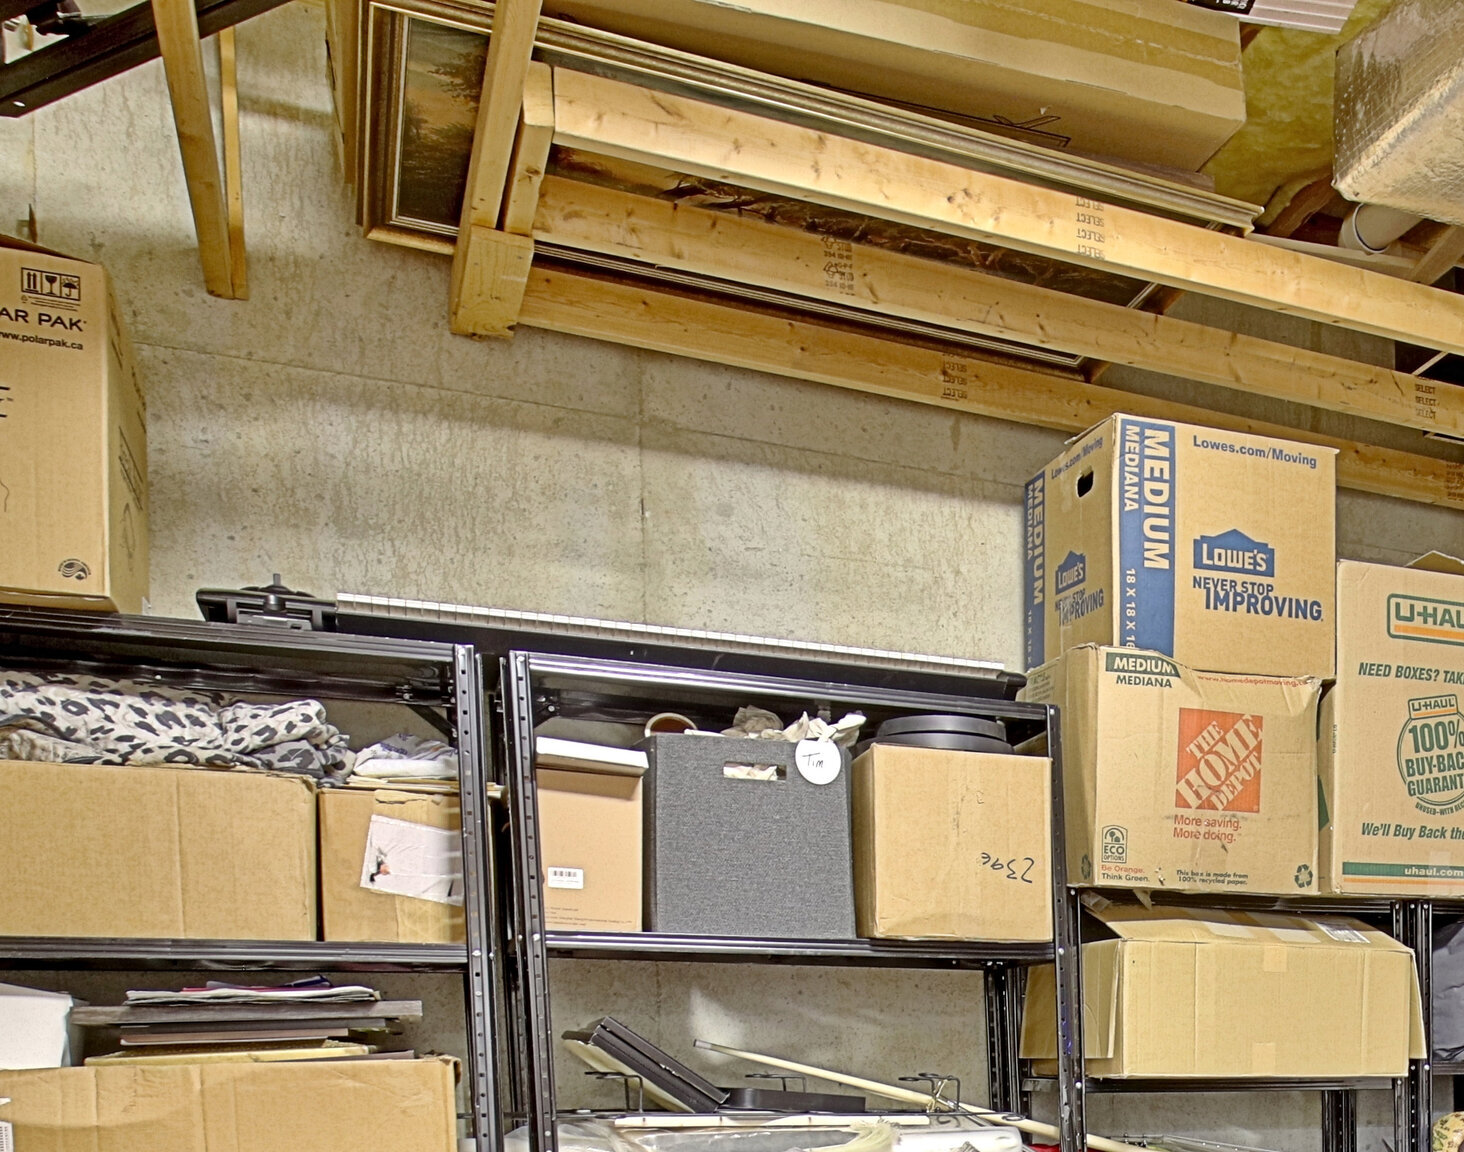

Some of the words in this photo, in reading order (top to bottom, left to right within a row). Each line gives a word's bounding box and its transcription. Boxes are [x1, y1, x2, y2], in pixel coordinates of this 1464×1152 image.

[38, 312, 83, 332] PAK
[1193, 435, 1317, 469] Lowes.com/Moving
[1125, 425, 1139, 512] MEDIANA
[1144, 428, 1170, 569] MEDIUM
[1033, 476, 1044, 605] MEDIUM
[1202, 543, 1267, 571] LOWE'S
[1058, 562, 1084, 588] LOWE'S
[1126, 569, 1136, 583] 18
[1126, 588, 1136, 597] X
[1193, 576, 1237, 591] NEVER
[1242, 581, 1274, 596] STOP
[1126, 602, 1136, 616] 18
[1126, 621, 1136, 630] X
[1114, 657, 1175, 674] MEDIUM
[1359, 662, 1392, 678] NEED
[1395, 666, 1440, 682] BOXES?
[1116, 674, 1173, 688] MEDIANA
[1412, 698, 1454, 712] U-HAUL
[1186, 721, 1225, 759] THE
[1176, 714, 1263, 809] HOME
[1210, 752, 1261, 811] DEPOT
[1174, 814, 1202, 826] More
[1204, 818, 1242, 831] saving.
[1362, 822, 1391, 837] We'll
[1393, 825, 1415, 841] Buy
[1418, 826, 1447, 840] Back
[1173, 827, 1201, 839] More
[1203, 830, 1236, 843] doing.
[1104, 845, 1124, 855] ECO
[1101, 873, 1123, 881] Think
[1125, 874, 1150, 882] Green.
[1114, 865, 1145, 874] Orange.
[1404, 866, 1464, 877] uhaul.com
